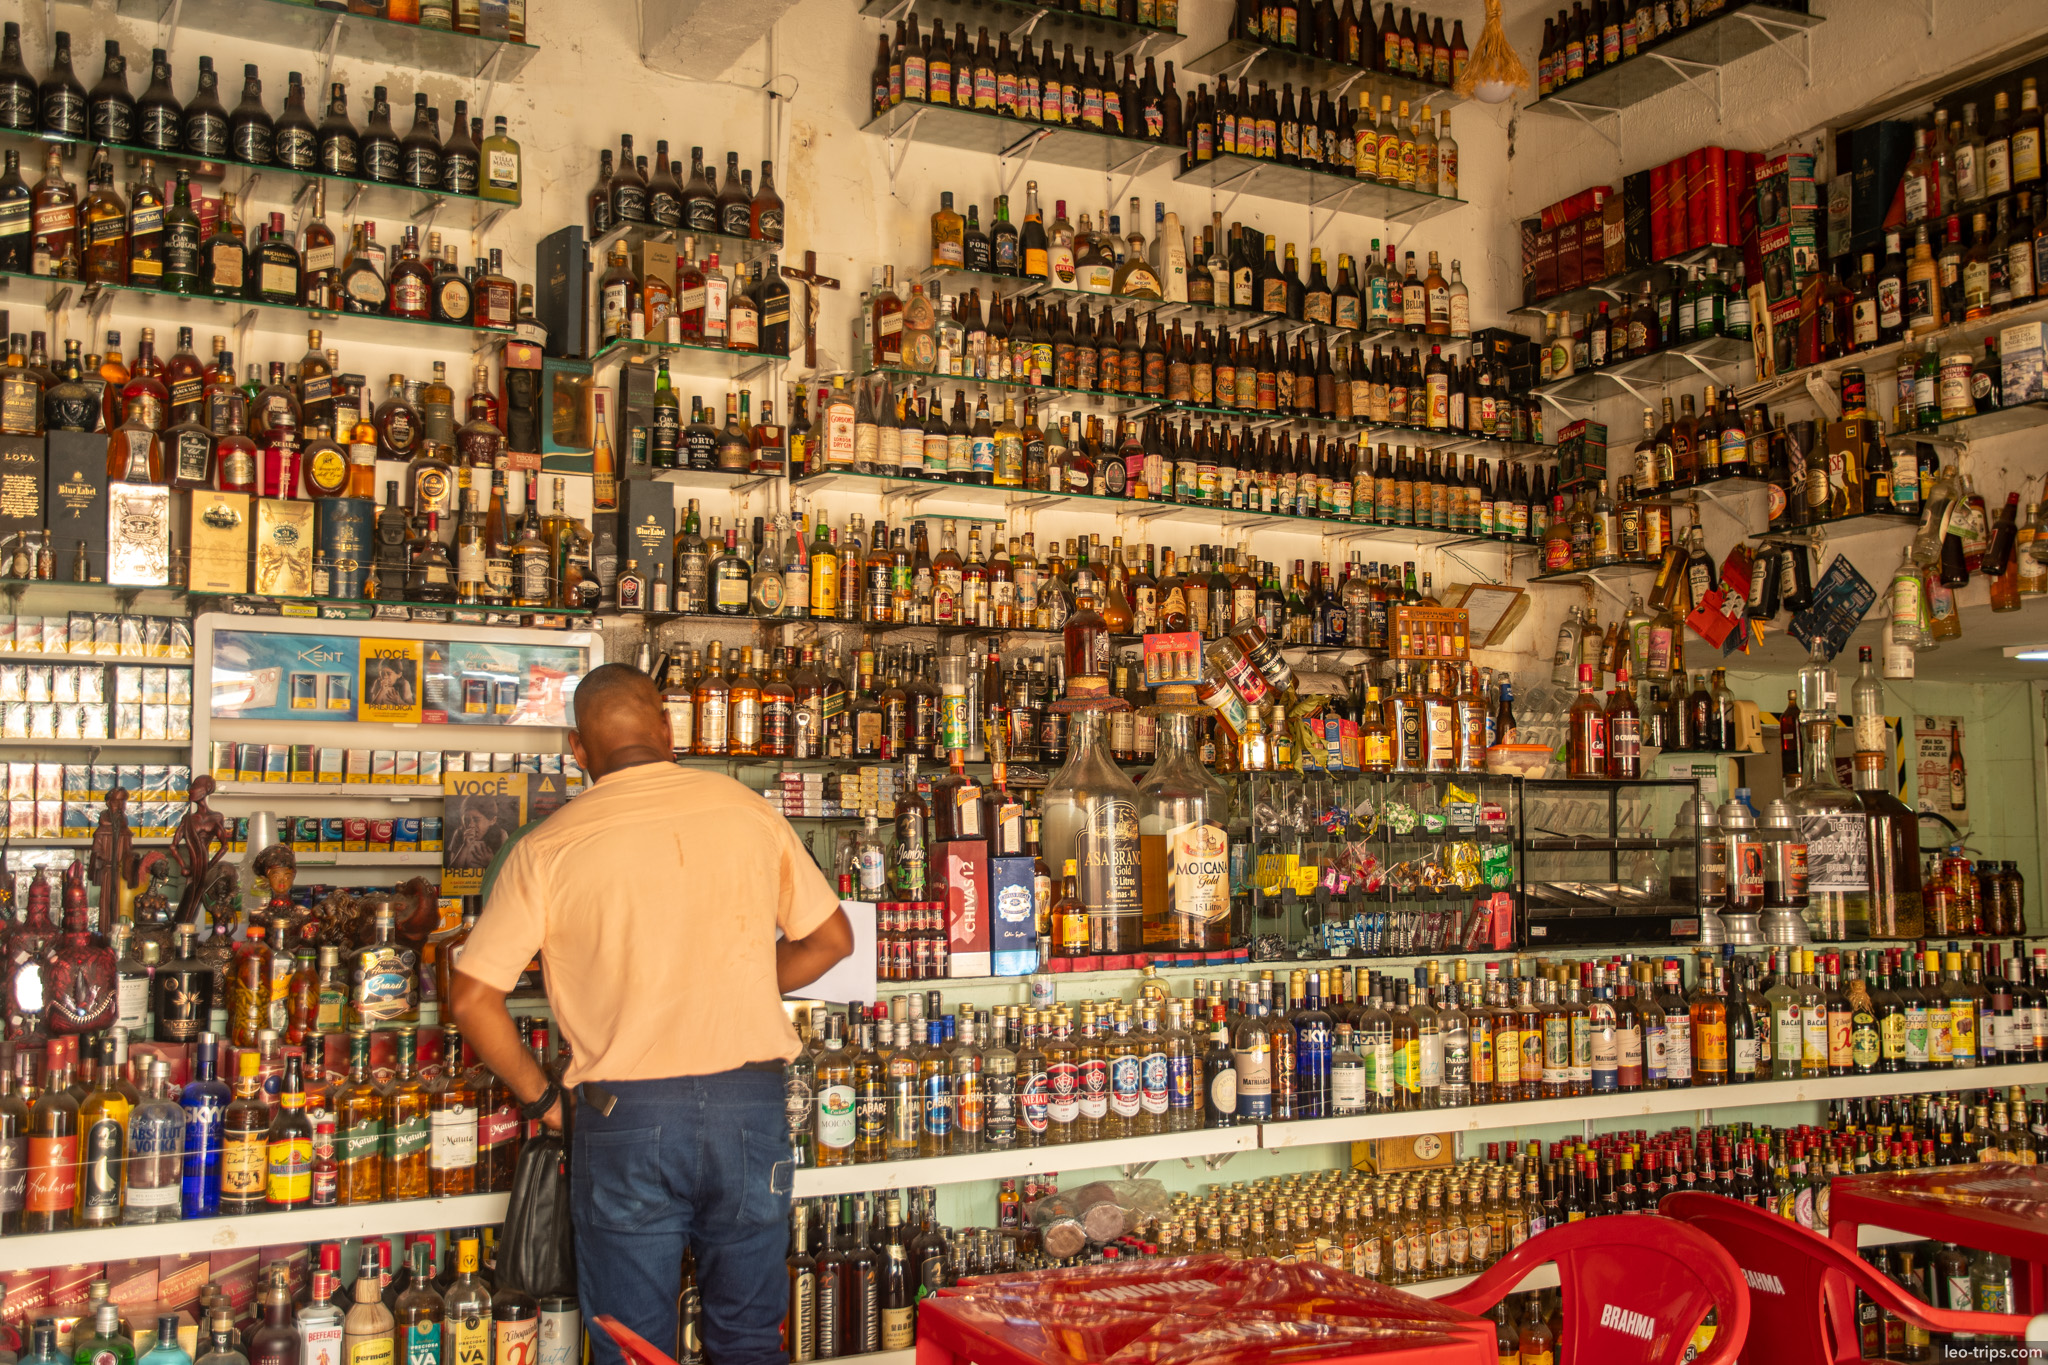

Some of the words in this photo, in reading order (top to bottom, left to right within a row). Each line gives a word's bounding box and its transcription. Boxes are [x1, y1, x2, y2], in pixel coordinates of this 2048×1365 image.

[1755, 163, 1788, 181] CAMELO
[1761, 237, 1789, 255] CAMELO
[1773, 308, 1800, 325] CAMELO
[1558, 428, 1585, 442] CAMELO
[58, 484, 76, 495] Blue
[76, 484, 96, 495] Label
[636, 526, 649, 536] Blue
[649, 527, 666, 536] Label
[298, 644, 344, 668] KENT
[374, 647, 409, 660] VOCÊ
[368, 703, 412, 711] PREJUDICA
[957, 704, 967, 720] 51
[1406, 722, 1415, 730] 51
[1471, 723, 1480, 731] 51
[454, 778, 508, 796] VOCÊ
[1424, 819, 1443, 827] Trident
[1828, 818, 1863, 830] Temos
[896, 846, 925, 866] Jambu
[1085, 852, 1108, 866] ASA
[963, 862, 974, 876] 12
[1114, 865, 1132, 876] Gold
[1175, 861, 1228, 874] MOICANA
[1109, 876, 1119, 886] 15
[1119, 876, 1135, 886] Litros
[1196, 876, 1218, 890] Gold
[1106, 890, 1127, 898] Salinas
[964, 879, 975, 932] CHIVAS
[1195, 903, 1204, 912] 15
[1204, 903, 1221, 912] Litros
[372, 975, 403, 990] Brasil
[1300, 1029, 1330, 1042] SKYY
[185, 1105, 225, 1123] SKYY
[131, 1126, 181, 1140] ABSOLUT
[490, 1120, 519, 1135] Matuta
[135, 1139, 176, 1151] VODKA
[348, 1134, 378, 1149] Matuta
[397, 1131, 426, 1146] Matuta
[442, 1136, 473, 1146] Matuta
[179, 1275, 203, 1290] Label
[1742, 1269, 1785, 1295] RAHMA
[17, 1294, 44, 1309] LABEL
[1600, 1304, 1655, 1340] BRAHMA
[308, 1330, 341, 1342] BEEFEATER
[410, 1354, 436, 1365] VA
[459, 1350, 483, 1362] VA
[1686, 1349, 1696, 1360] 51
